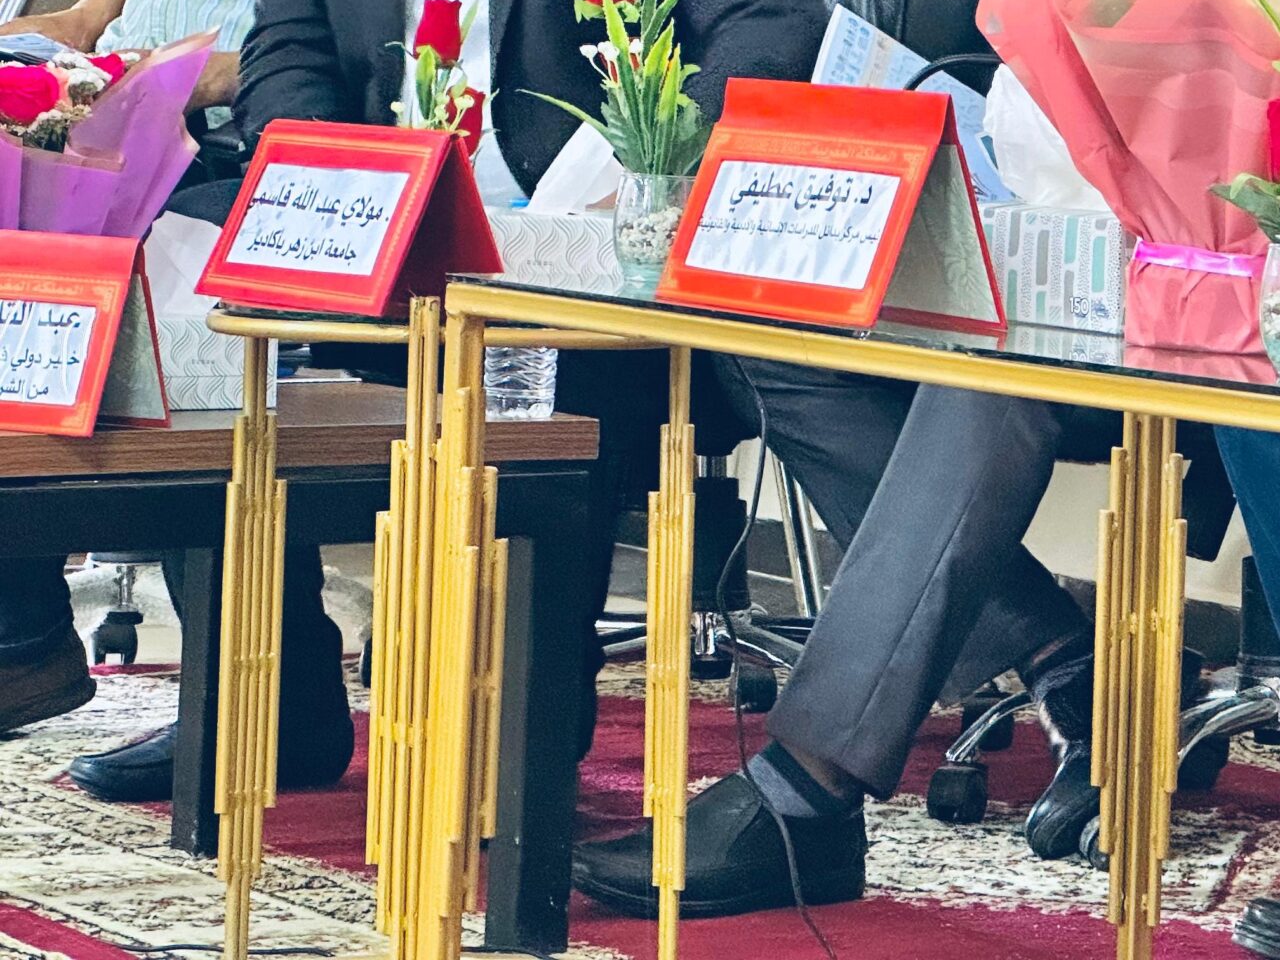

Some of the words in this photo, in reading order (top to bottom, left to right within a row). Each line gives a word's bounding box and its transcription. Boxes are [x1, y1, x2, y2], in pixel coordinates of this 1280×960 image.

[728, 170, 794, 213] عطيفي
[794, 173, 853, 212] توفيق
[315, 196, 341, 221] عبد
[341, 195, 384, 227] مولاي
[281, 236, 306, 259] زهر
[324, 238, 357, 266] جامعة
[1069, 296, 1089, 315] 150
[10, 347, 42, 371] دولي
[26, 384, 49, 400] من
